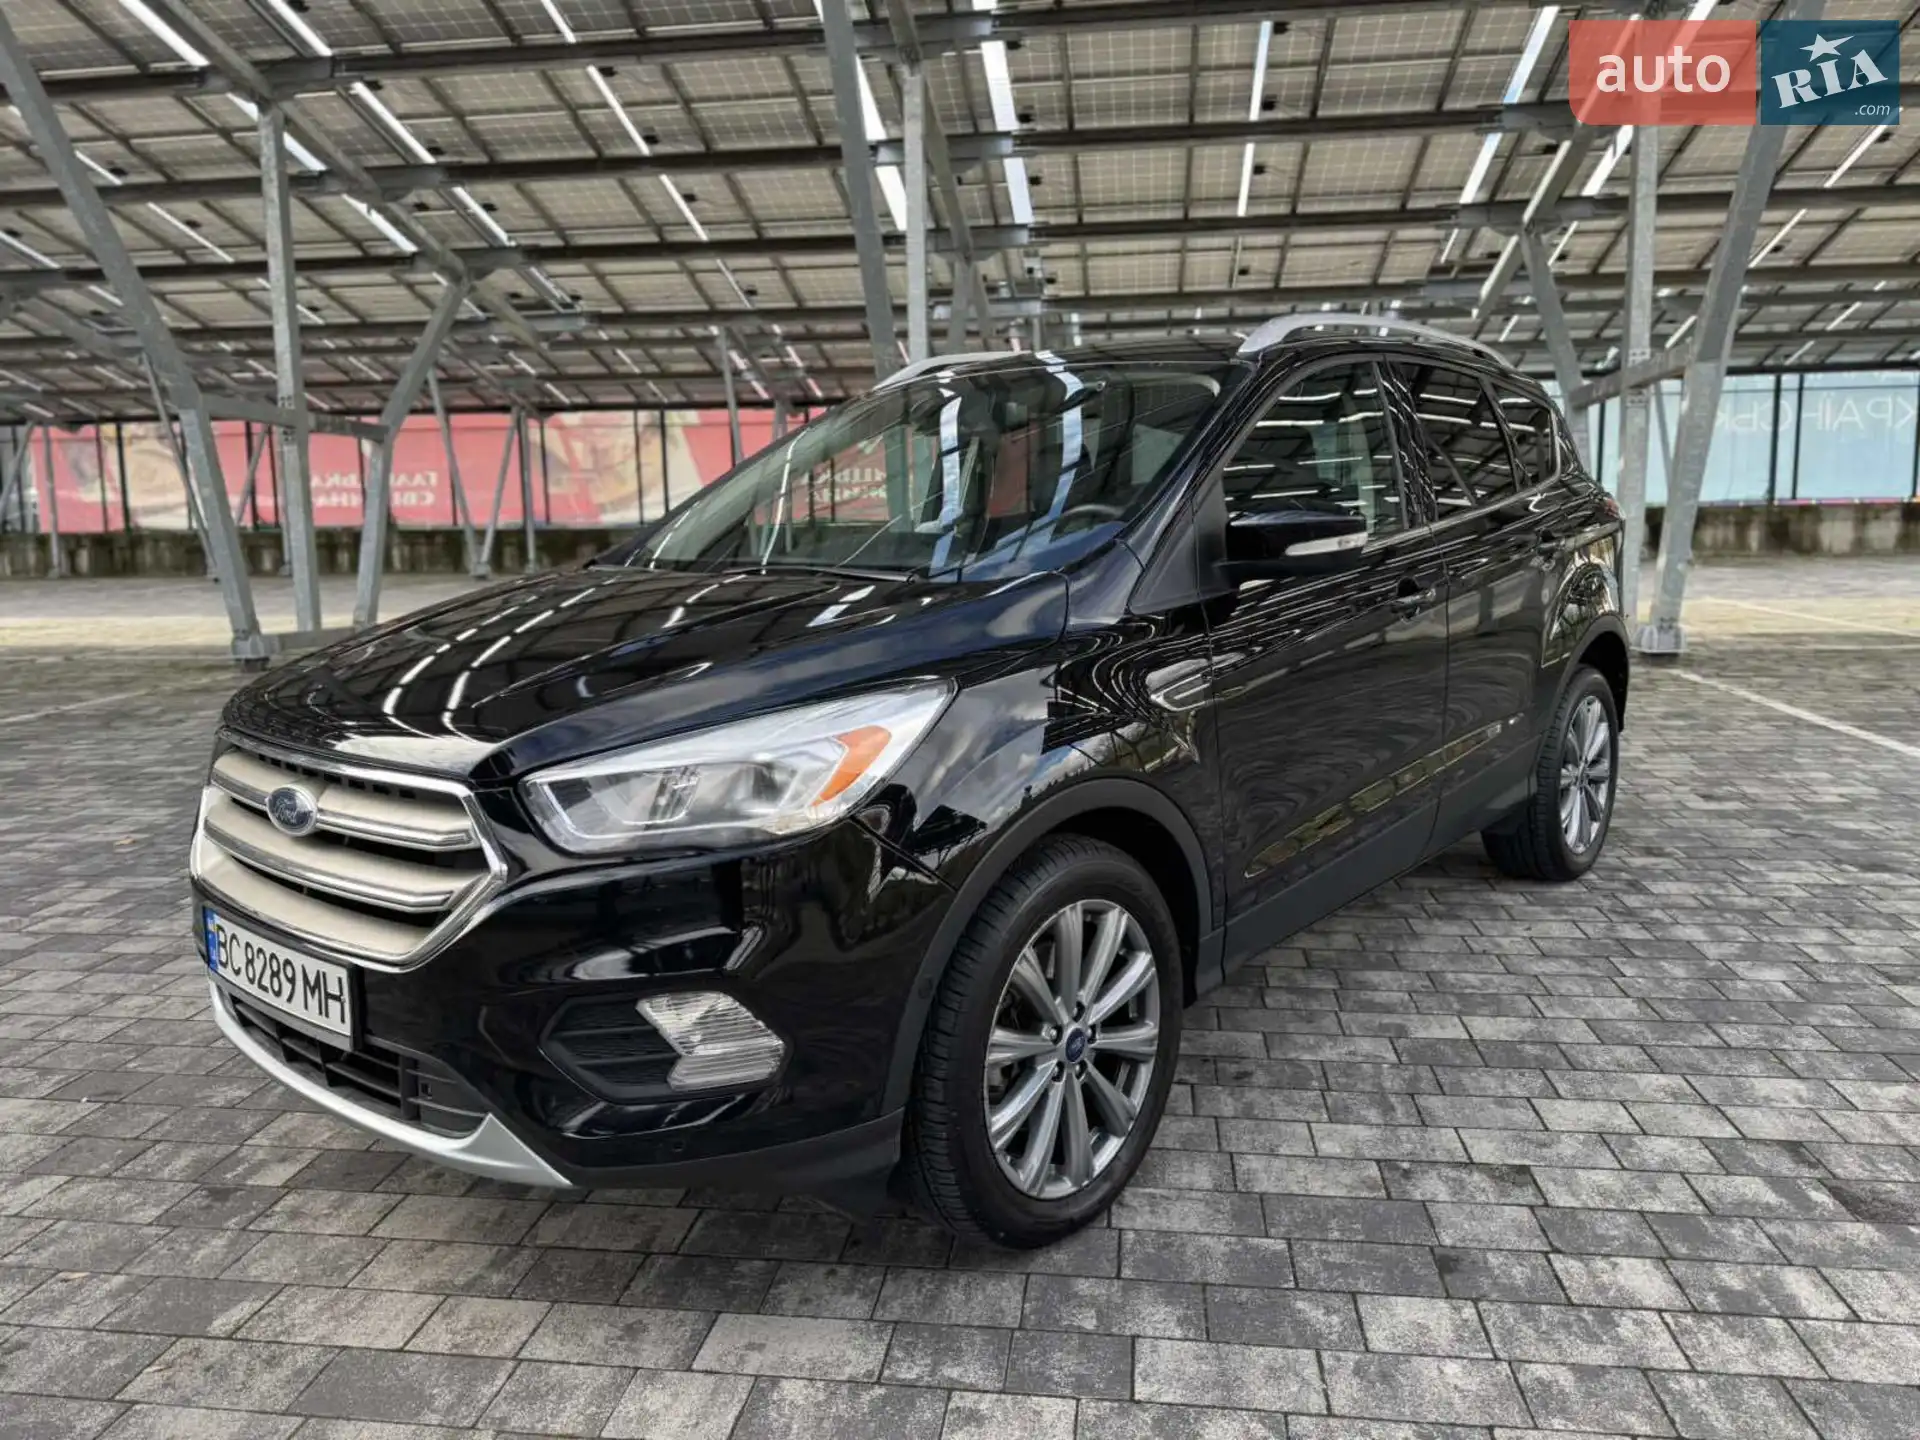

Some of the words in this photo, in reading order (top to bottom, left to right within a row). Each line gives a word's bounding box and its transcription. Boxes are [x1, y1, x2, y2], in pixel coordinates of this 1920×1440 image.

[216, 924, 242, 976] BC
[244, 941, 296, 1004] 8289
[301, 963, 346, 1024] MH
